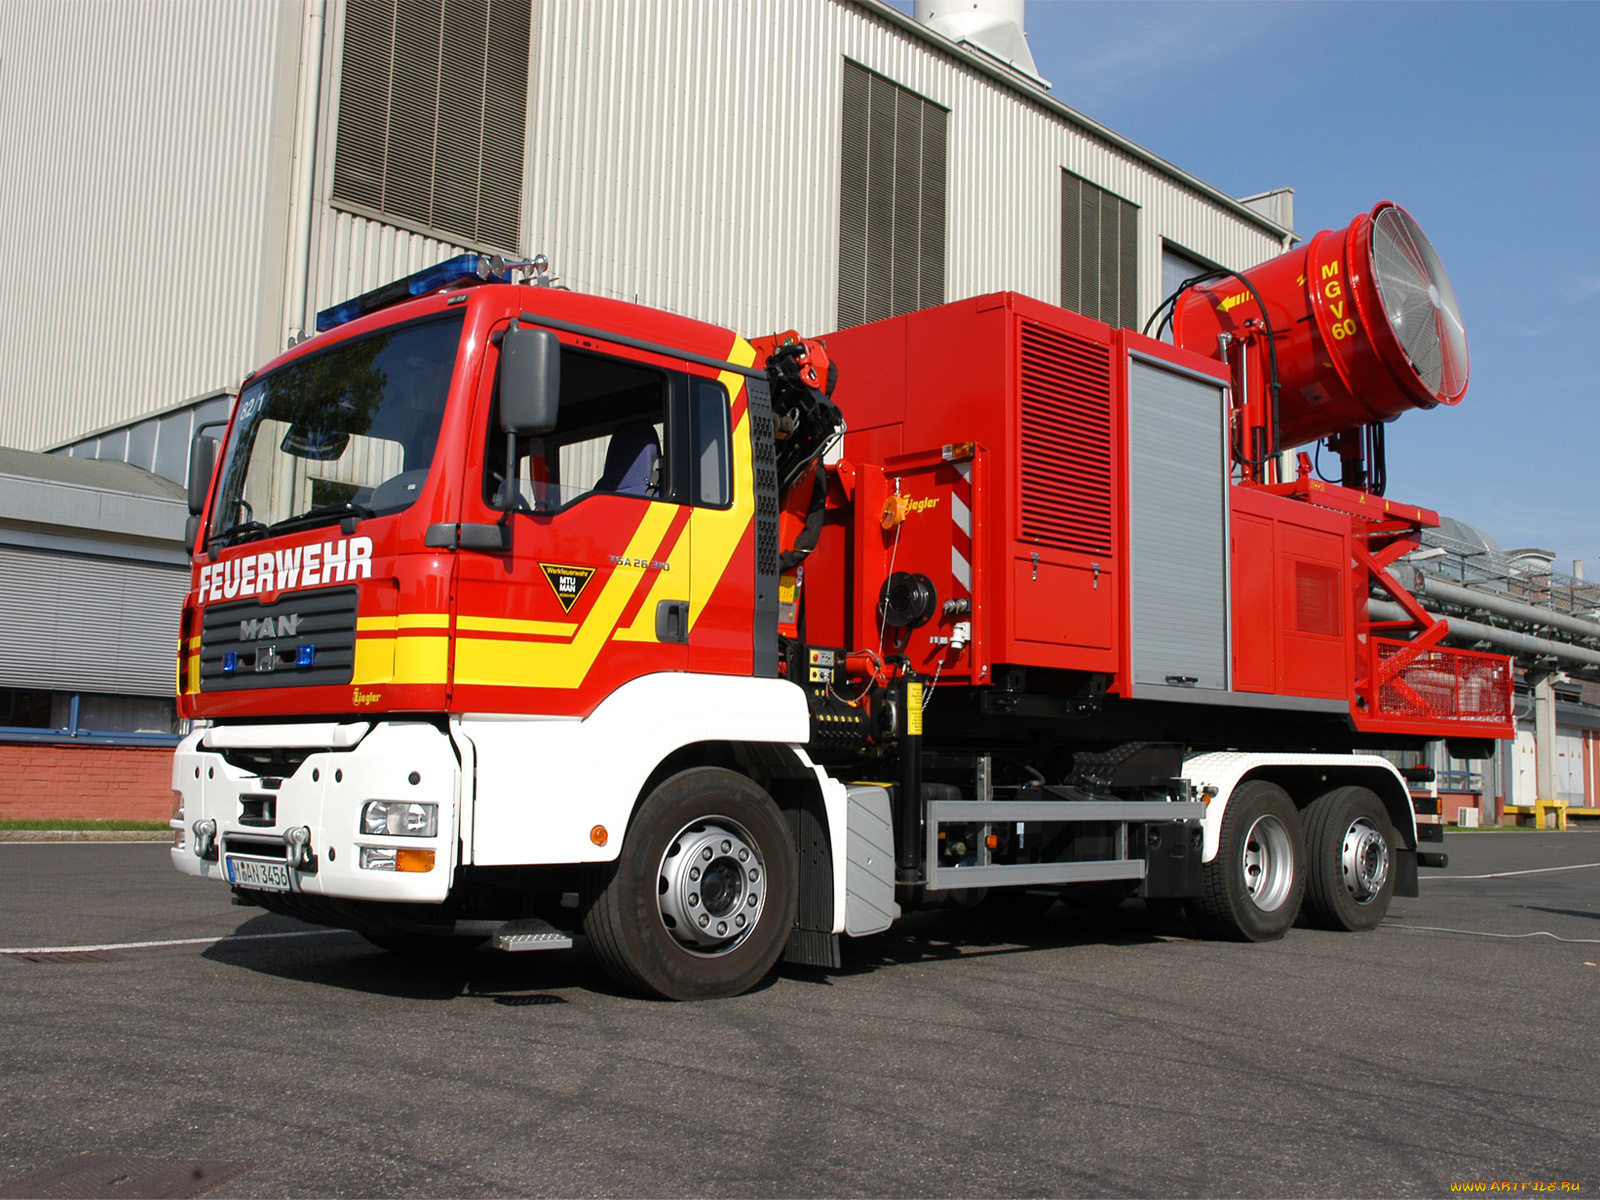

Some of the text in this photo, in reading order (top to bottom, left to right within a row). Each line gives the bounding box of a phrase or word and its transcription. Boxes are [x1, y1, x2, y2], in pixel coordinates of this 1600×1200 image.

[1331, 319, 1357, 340] 60
[240, 392, 265, 420] 82/1
[198, 536, 373, 604] FEUERWEHR
[609, 555, 670, 571] TGA 26.310
[559, 576, 576, 585] MTU
[559, 584, 576, 593] MAN
[240, 613, 302, 641] MAN
[260, 864, 288, 887] 3456
